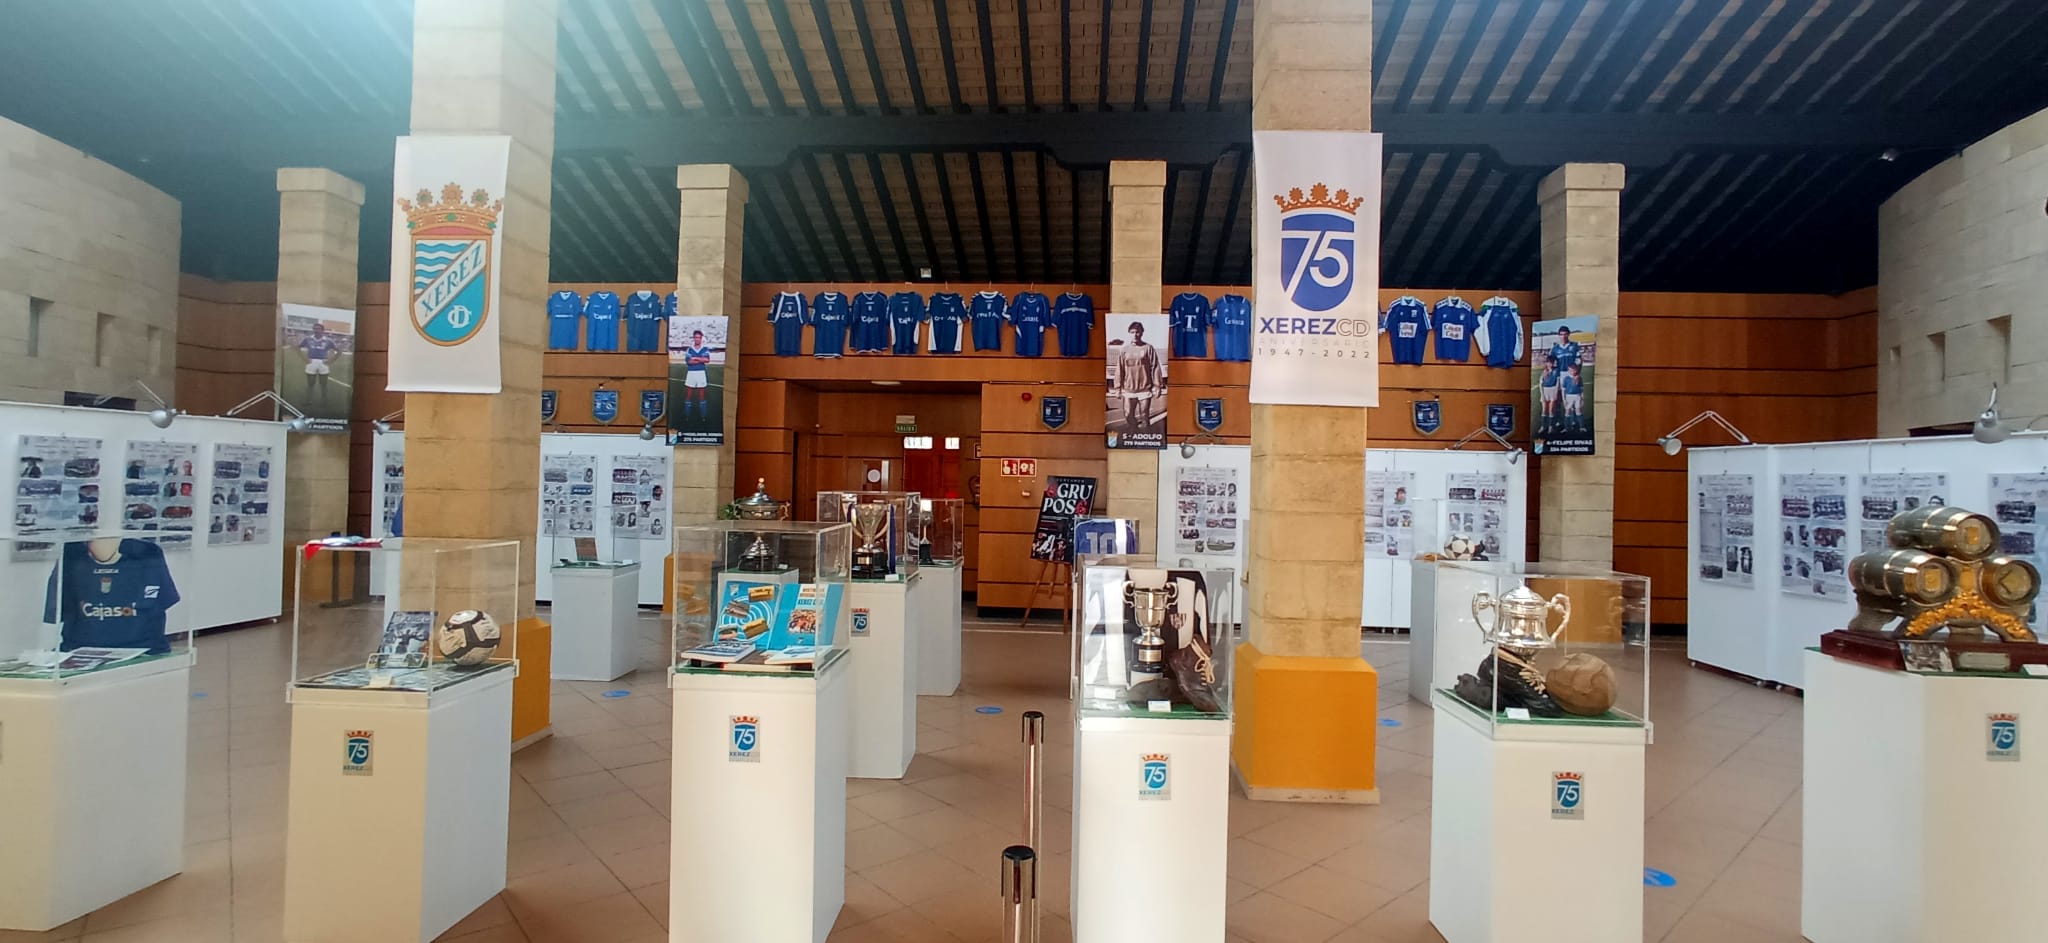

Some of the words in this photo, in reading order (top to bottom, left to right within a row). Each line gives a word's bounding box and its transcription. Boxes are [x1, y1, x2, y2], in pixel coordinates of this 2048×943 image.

[421, 242, 482, 317] XEREZ
[1281, 230, 1354, 300] 75
[1043, 497, 1076, 515] POS
[1057, 483, 1093, 500] GRU
